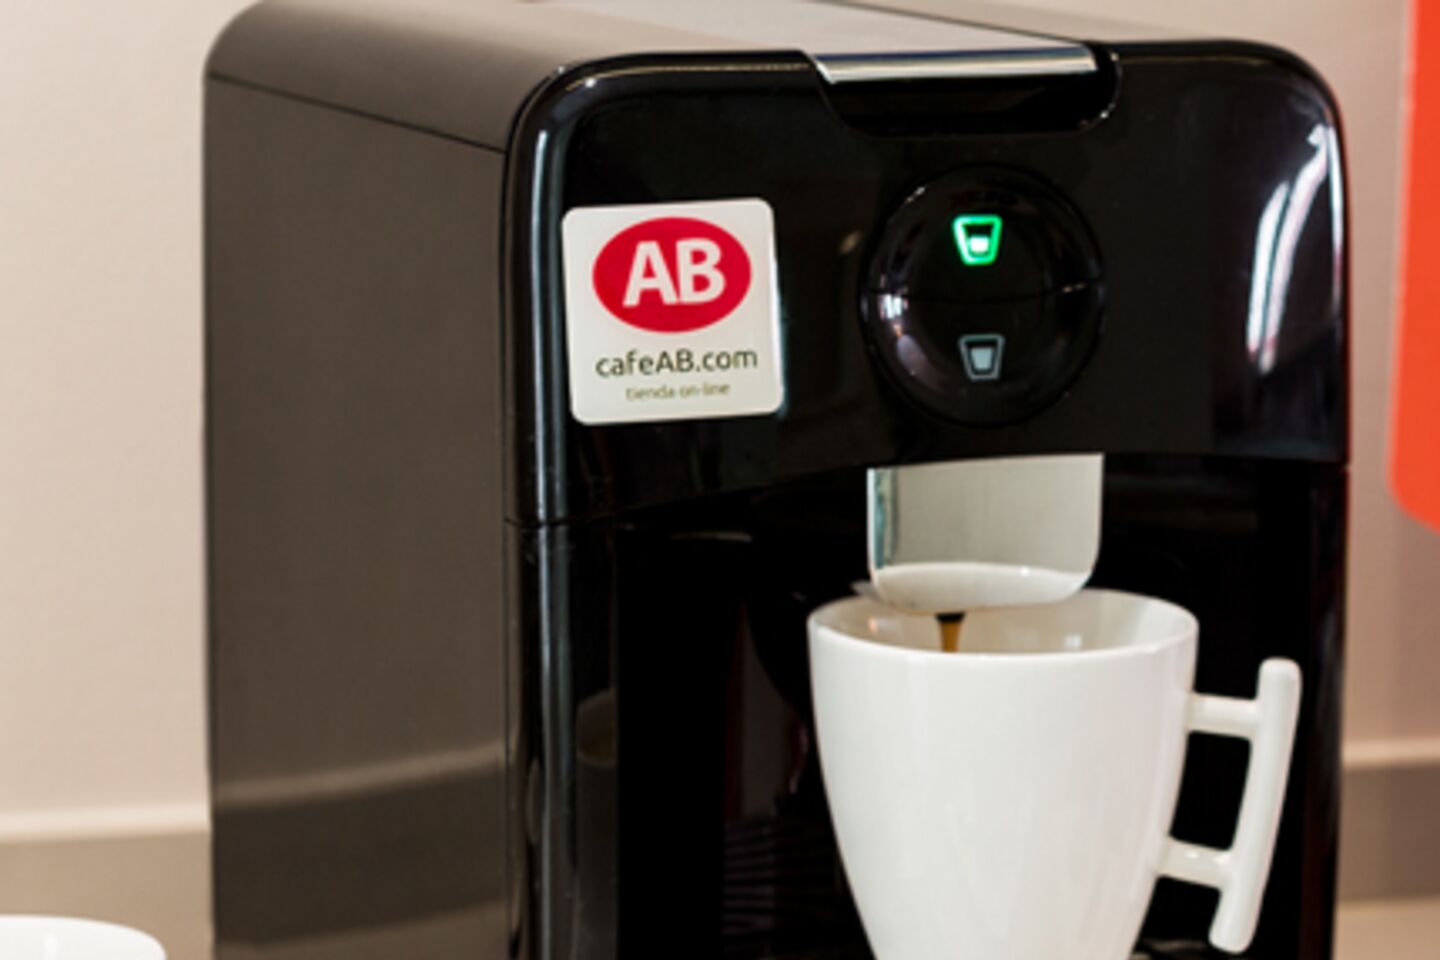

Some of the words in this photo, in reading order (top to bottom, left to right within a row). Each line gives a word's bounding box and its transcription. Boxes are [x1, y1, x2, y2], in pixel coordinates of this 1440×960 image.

[623, 238, 726, 308] AB
[595, 348, 758, 378] cafeAB.com
[625, 384, 675, 400] tienda
